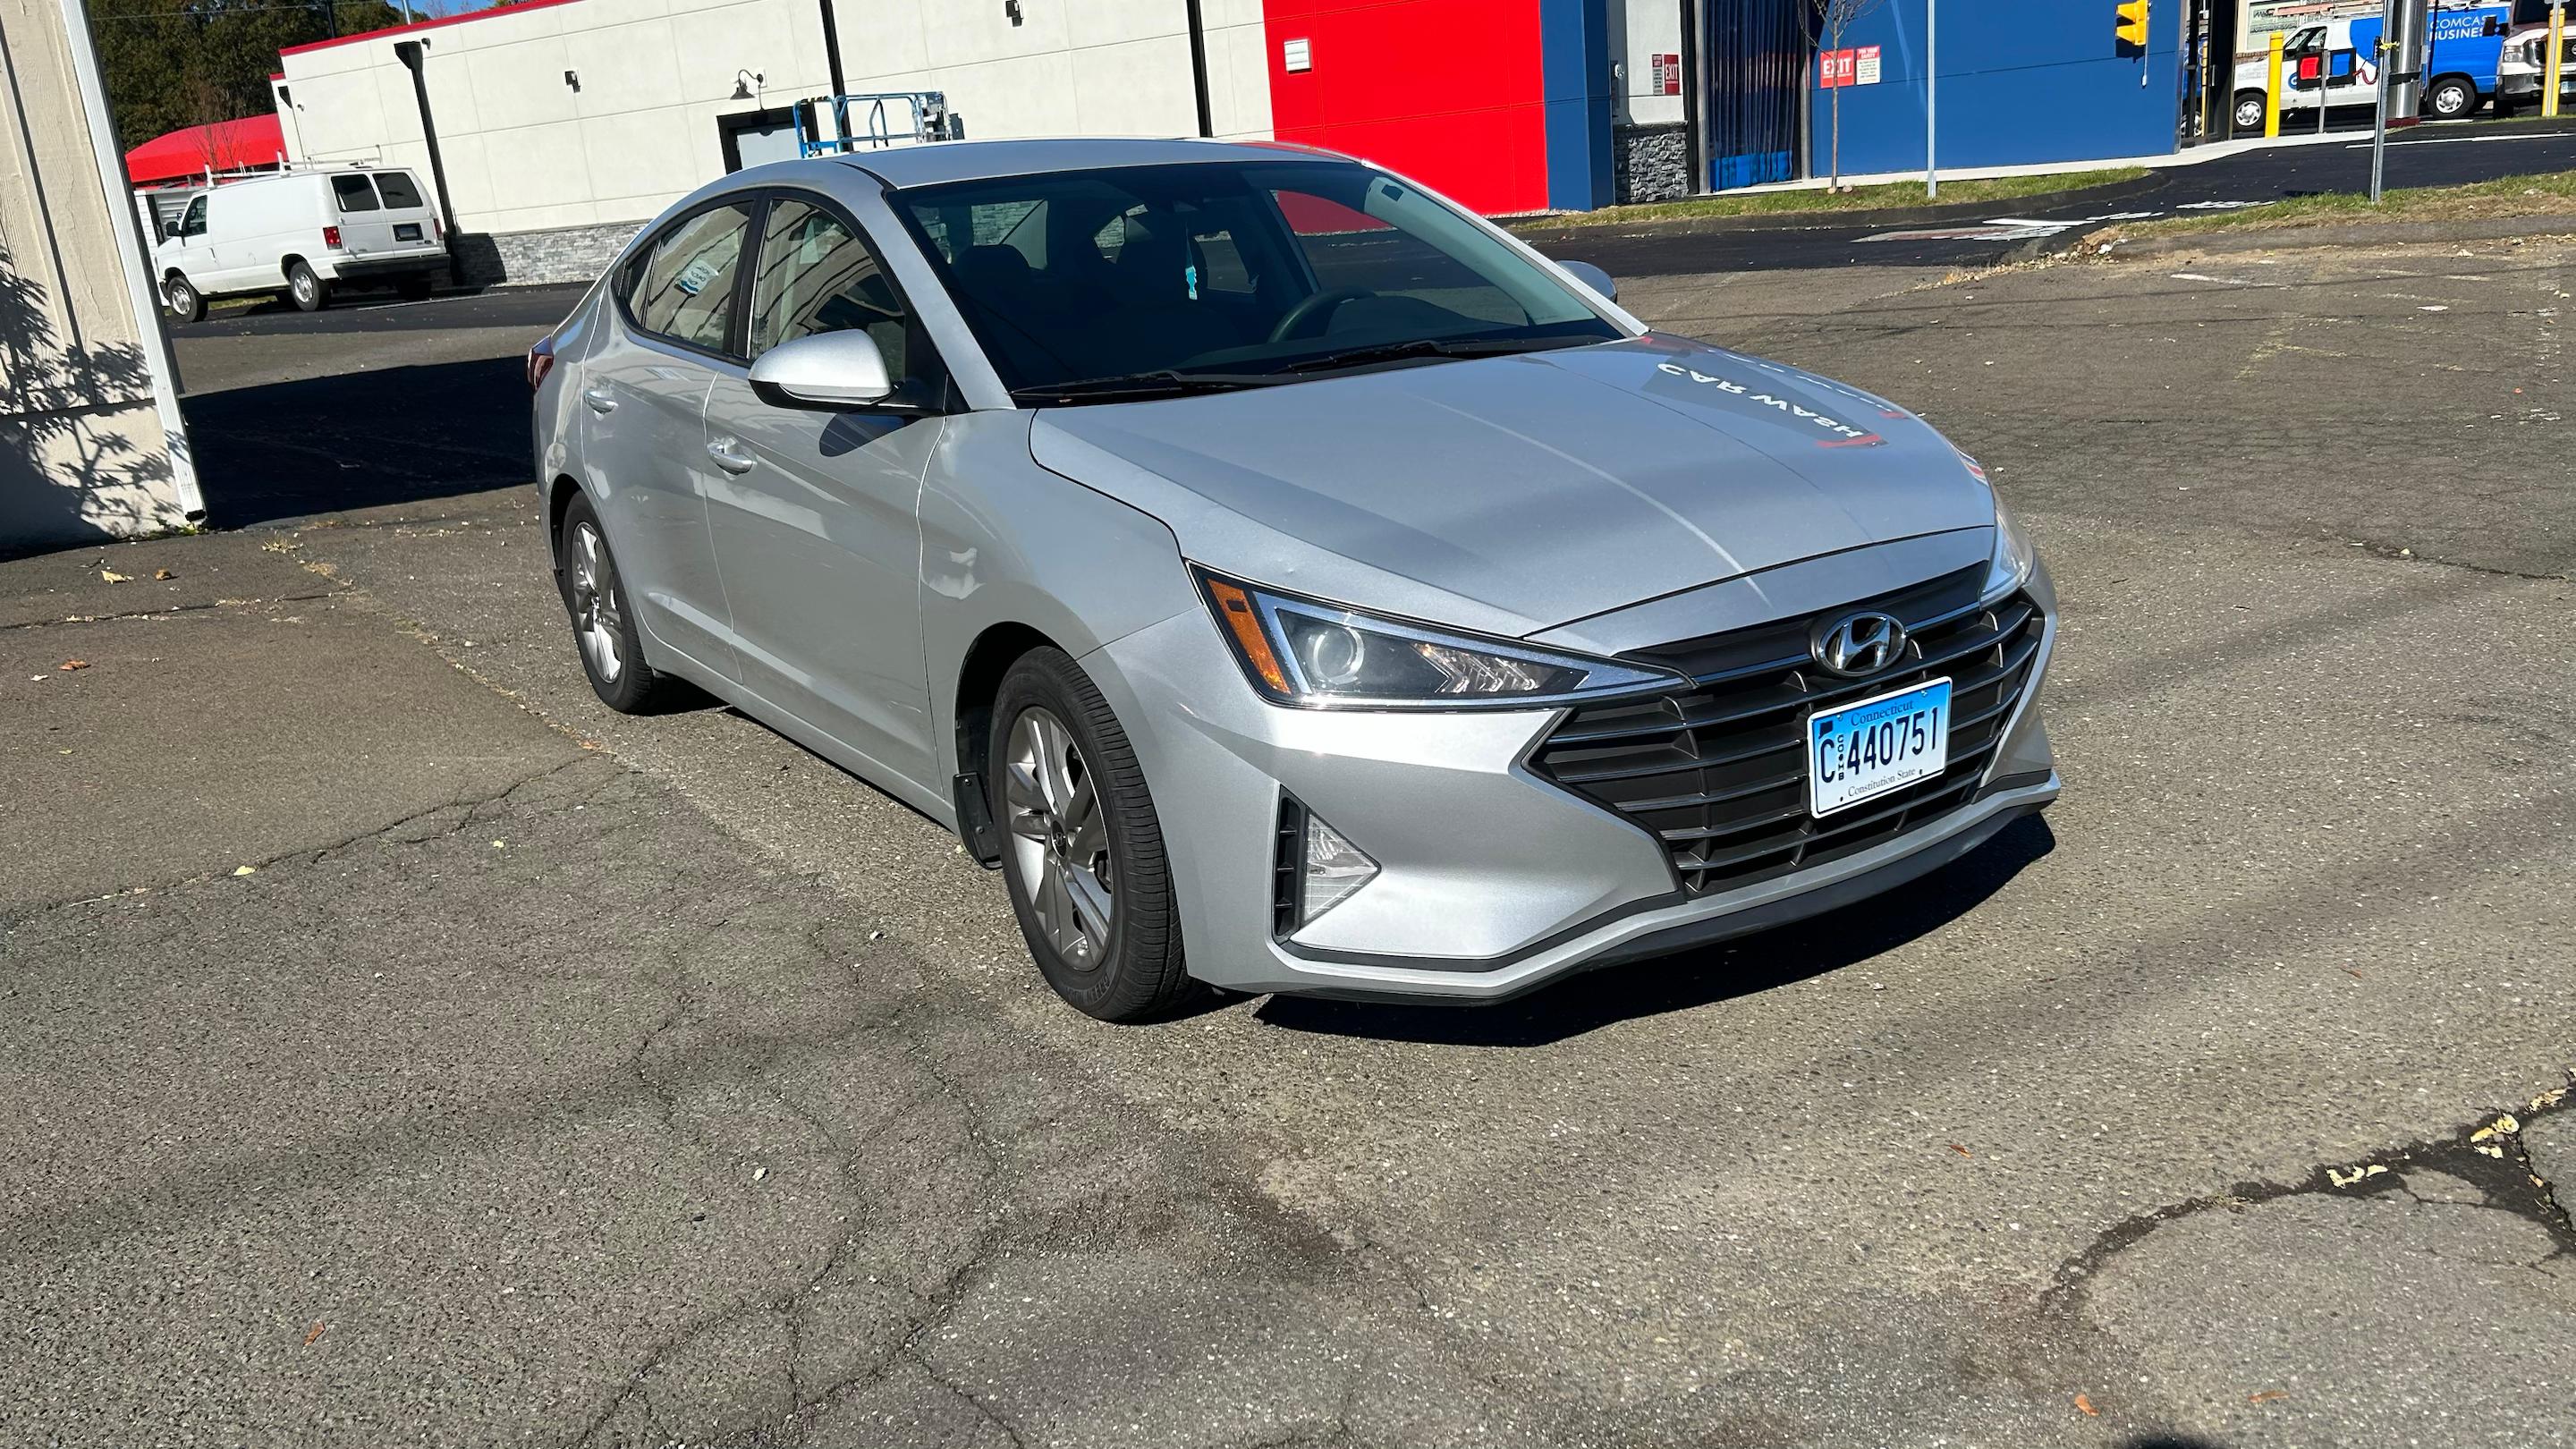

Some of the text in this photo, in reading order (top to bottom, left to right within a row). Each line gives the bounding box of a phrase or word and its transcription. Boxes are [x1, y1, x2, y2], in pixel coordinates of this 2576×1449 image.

[2430, 15, 2487, 30] COMCAS
[2429, 27, 2484, 42] BUSINES
[1665, 64, 1679, 80] EXIT
[1823, 57, 1852, 75] EXIT
[1851, 699, 1914, 726] Connecticut
[1847, 707, 1938, 775] 440751
[1848, 767, 1916, 797] Constitution State
